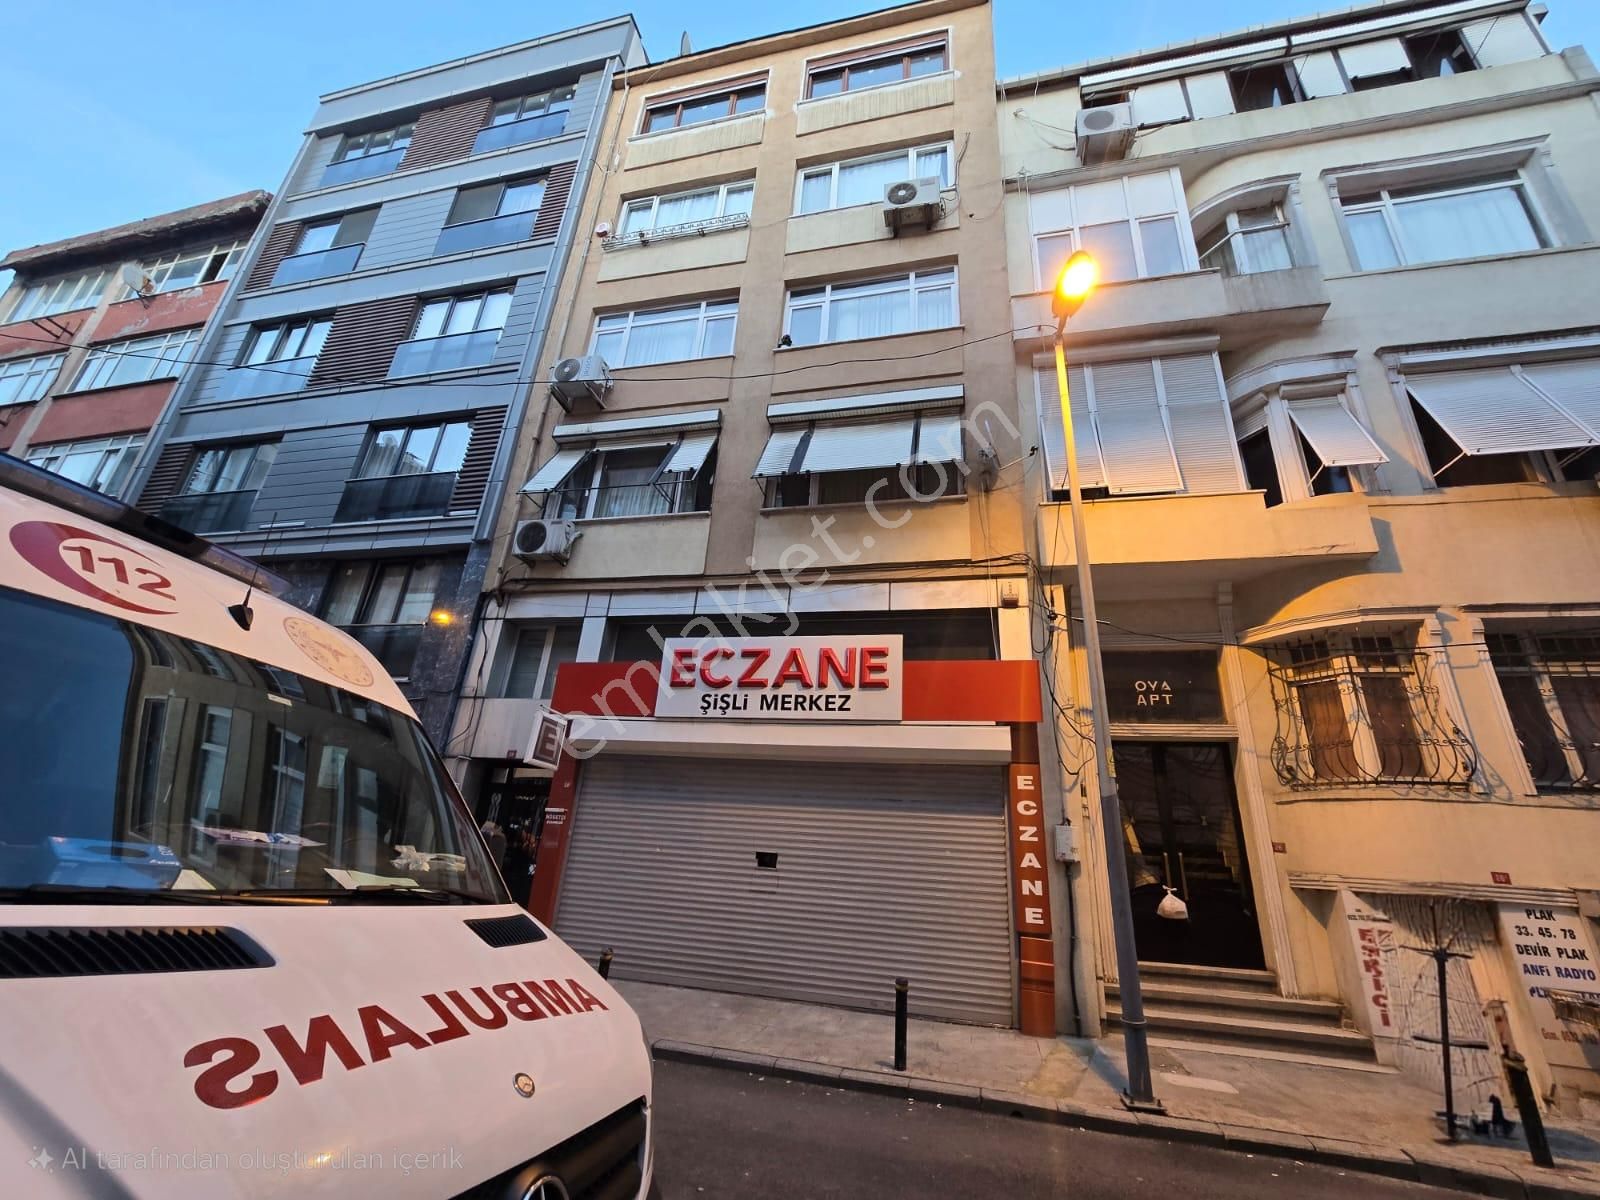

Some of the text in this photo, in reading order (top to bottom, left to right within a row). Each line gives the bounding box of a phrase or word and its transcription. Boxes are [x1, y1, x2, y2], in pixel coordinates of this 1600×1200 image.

[63, 545, 177, 601] 112
[669, 647, 890, 689] ECZANE
[1134, 680, 1172, 692] OYA
[759, 693, 852, 712] MERKEZ
[1137, 694, 1174, 706] APT
[1016, 775, 1045, 925] ECZANE
[1525, 908, 1557, 921] PLAK
[1514, 925, 1577, 940] 33. 45. 78
[1515, 942, 1589, 961] DEVİR PLAK
[1554, 965, 1596, 981] RADYO
